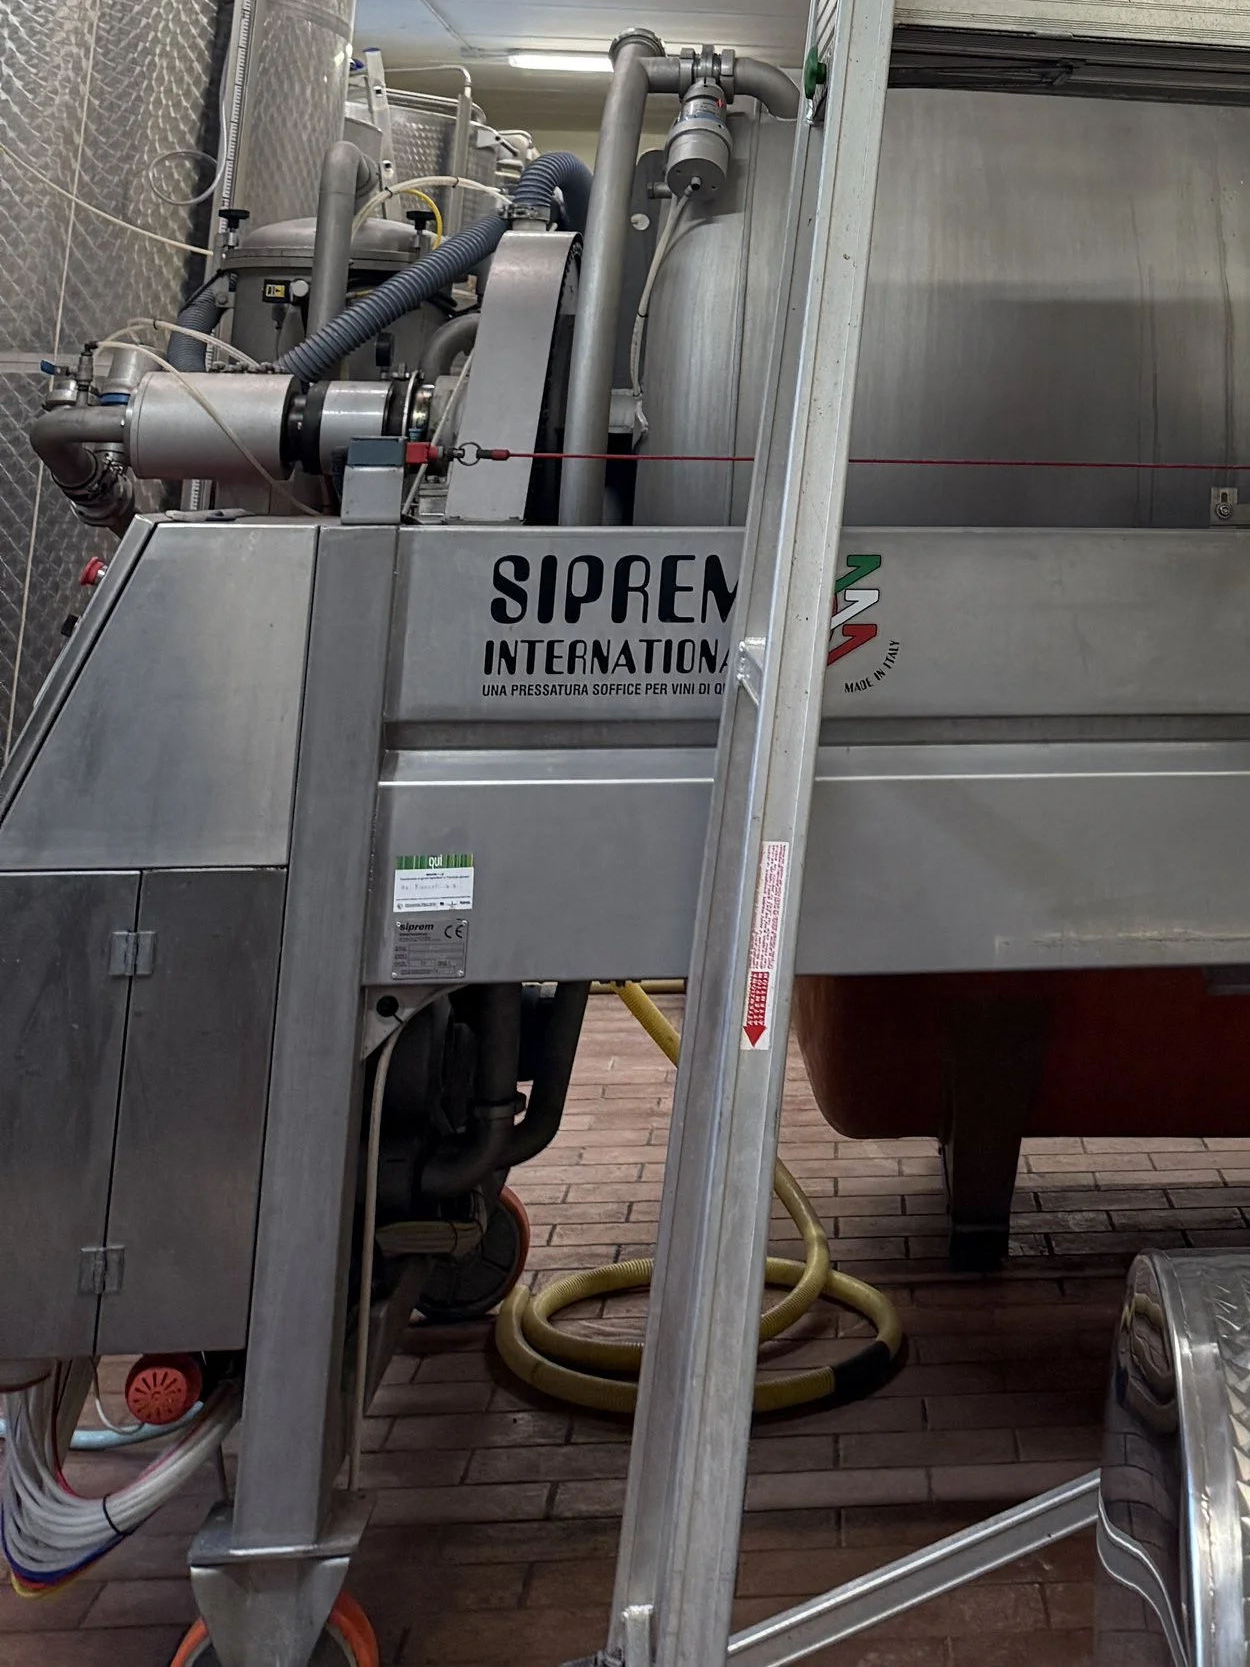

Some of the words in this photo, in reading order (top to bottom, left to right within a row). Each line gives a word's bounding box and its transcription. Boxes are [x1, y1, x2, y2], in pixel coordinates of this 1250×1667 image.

[483, 638, 730, 675] INTERNATION
[844, 677, 874, 693] MADE
[873, 668, 886, 681] IN
[882, 639, 900, 669] ITALY
[482, 684, 508, 697] UNA
[510, 683, 589, 697] PRESSATURA
[592, 683, 642, 696] SOFFICE
[645, 682, 668, 695] PER
[671, 682, 695, 695] VINI
[698, 682, 710, 695] DI
[428, 854, 443, 870] qui
